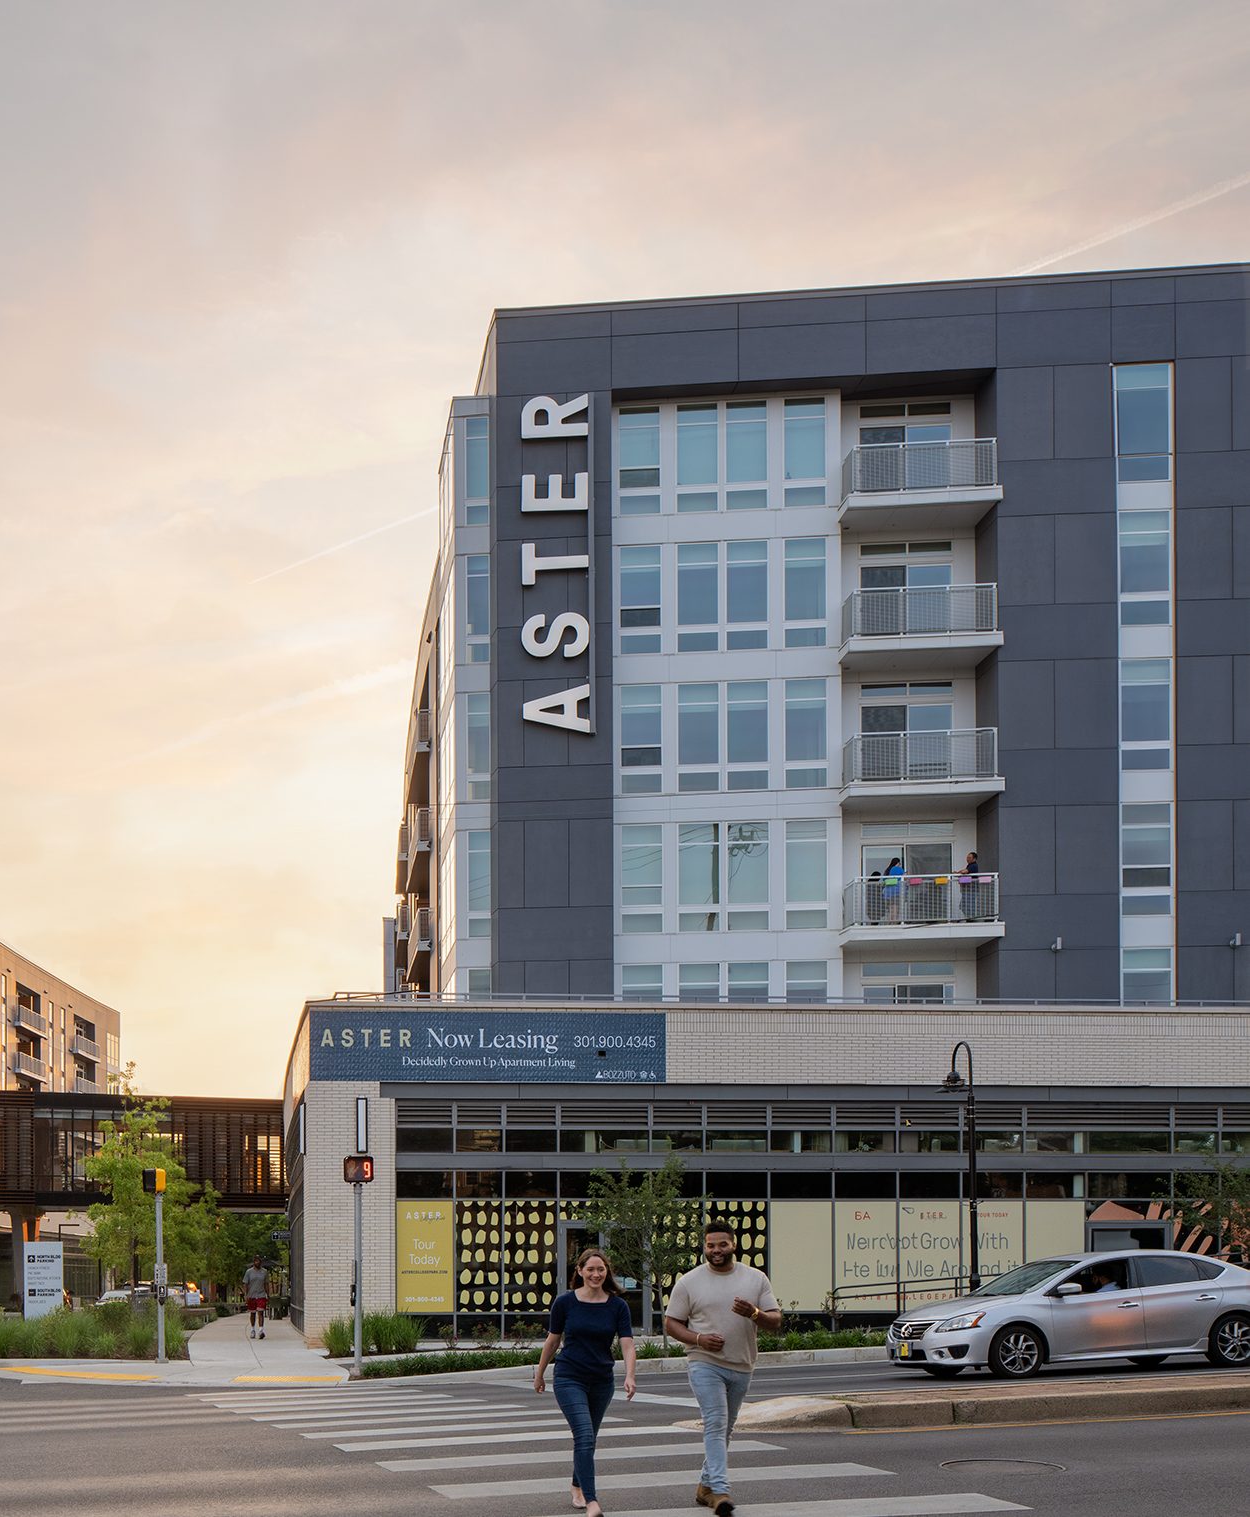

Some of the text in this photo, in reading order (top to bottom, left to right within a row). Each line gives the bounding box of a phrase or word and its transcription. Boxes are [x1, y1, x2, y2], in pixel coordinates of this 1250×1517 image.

[521, 393, 591, 734] ASTER
[320, 1027, 657, 1054] ASTER Now Leasing 301.900.4345
[402, 1056, 576, 1069] Decidedly Grown Up Apartment Living
[603, 1070, 636, 1079] BOZZUTO
[363, 1161, 371, 1178] 9
[405, 1211, 442, 1220] ASTER
[413, 1238, 436, 1250] Tour
[409, 1253, 441, 1268] Today
[939, 1259, 1001, 1278] Arond
